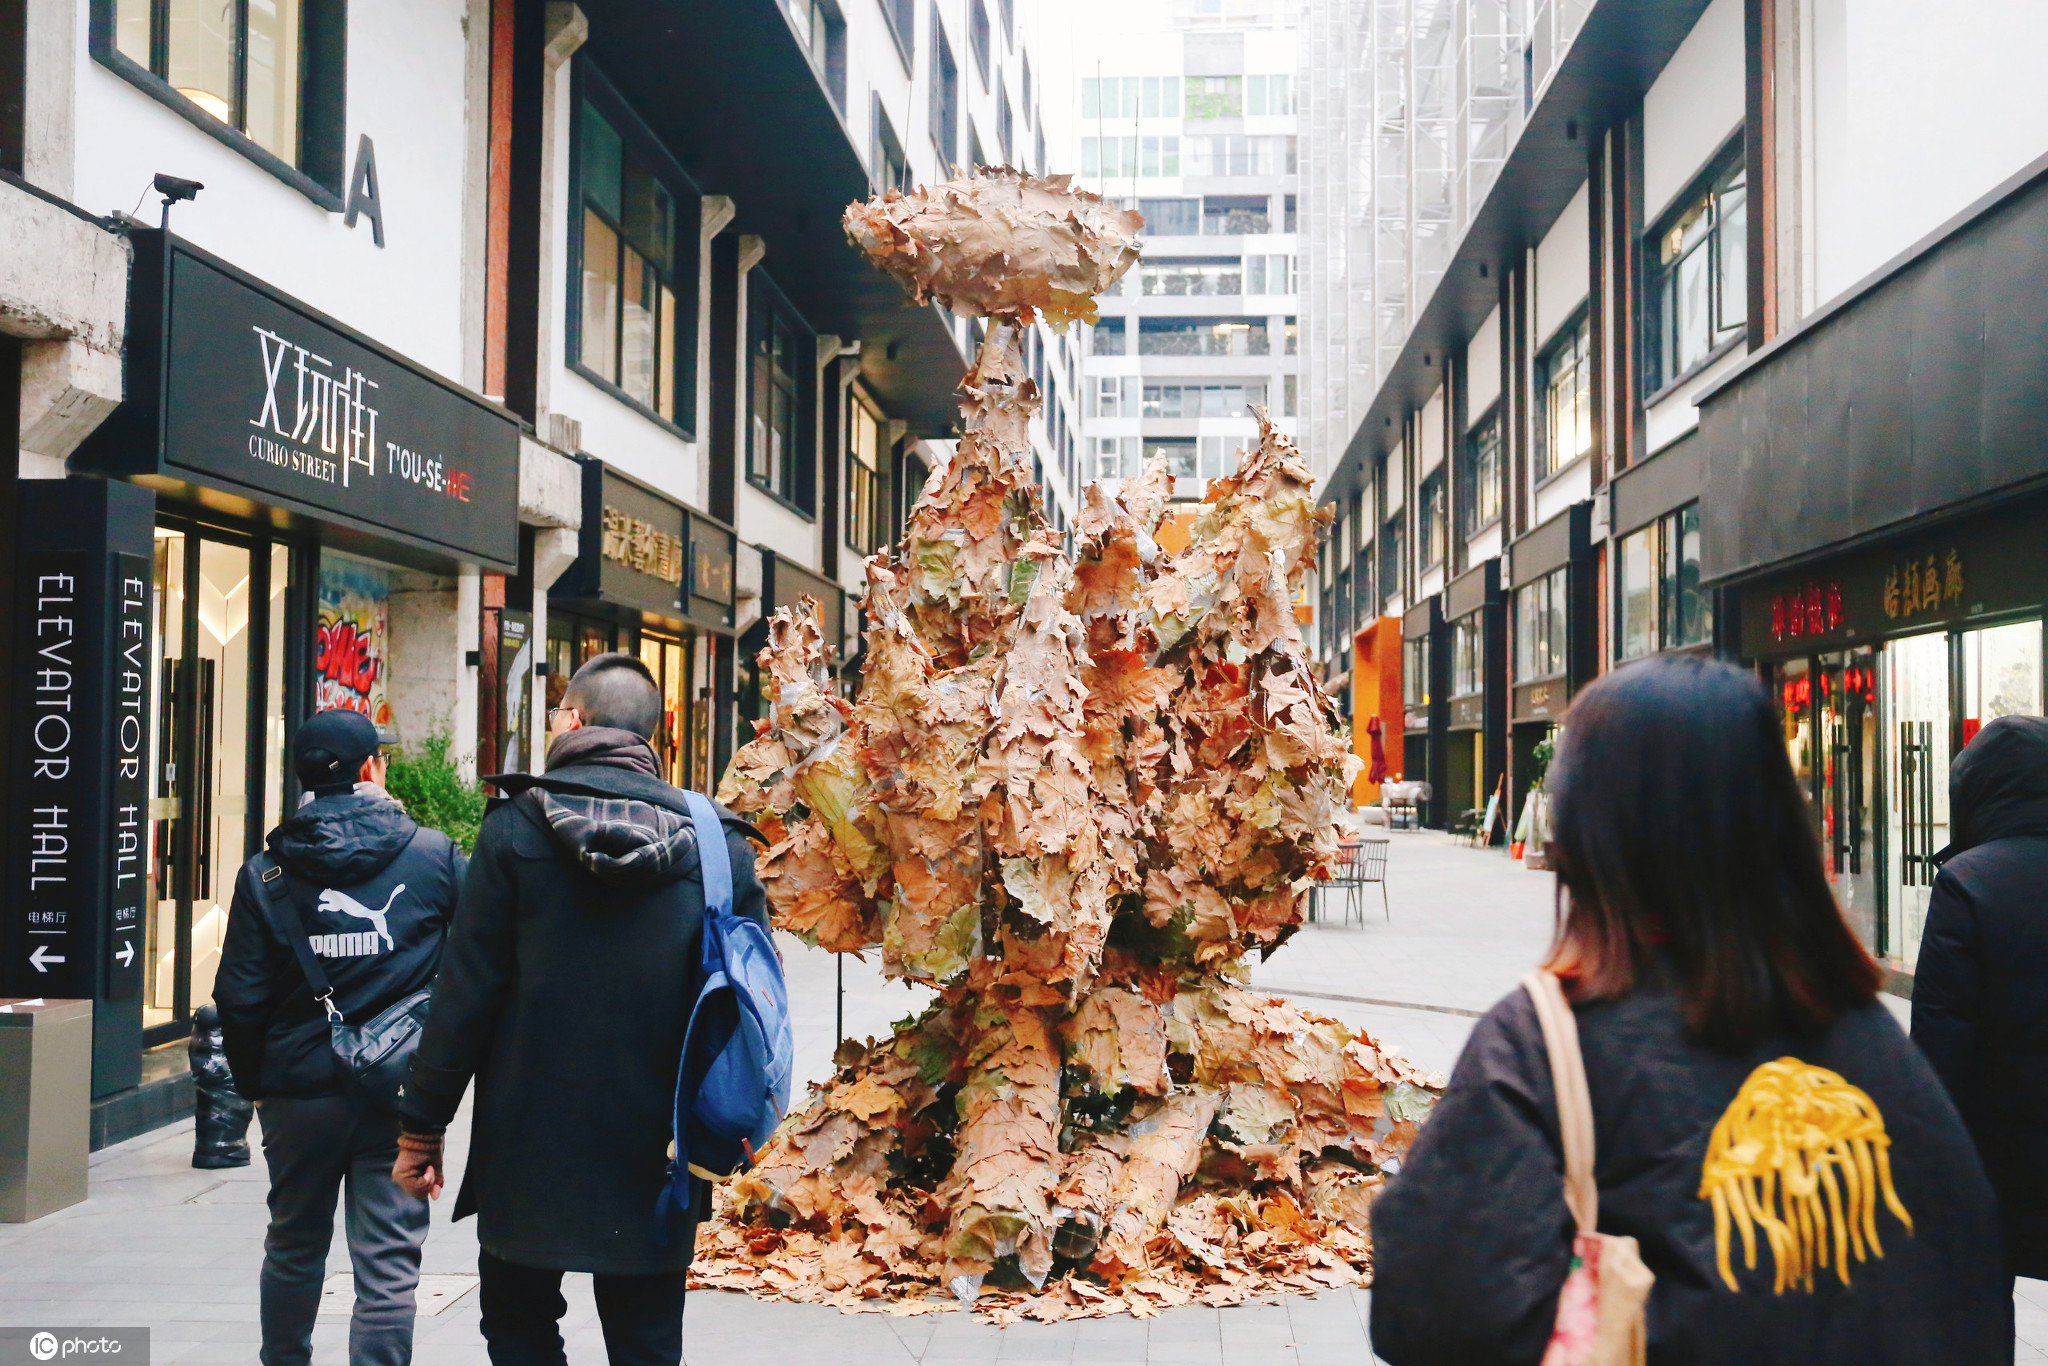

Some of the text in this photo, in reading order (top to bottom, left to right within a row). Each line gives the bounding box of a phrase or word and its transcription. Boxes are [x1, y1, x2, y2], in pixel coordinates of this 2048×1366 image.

[343, 133, 385, 249] A
[248, 434, 337, 484] CURIO STREET
[250, 325, 379, 488] 文玩街
[31, 572, 74, 892] ELEVATOR HALL
[117, 576, 143, 889] ELEVATOR HALL
[28, 911, 67, 924] 电梯厅
[115, 906, 137, 921] 电梯厅
